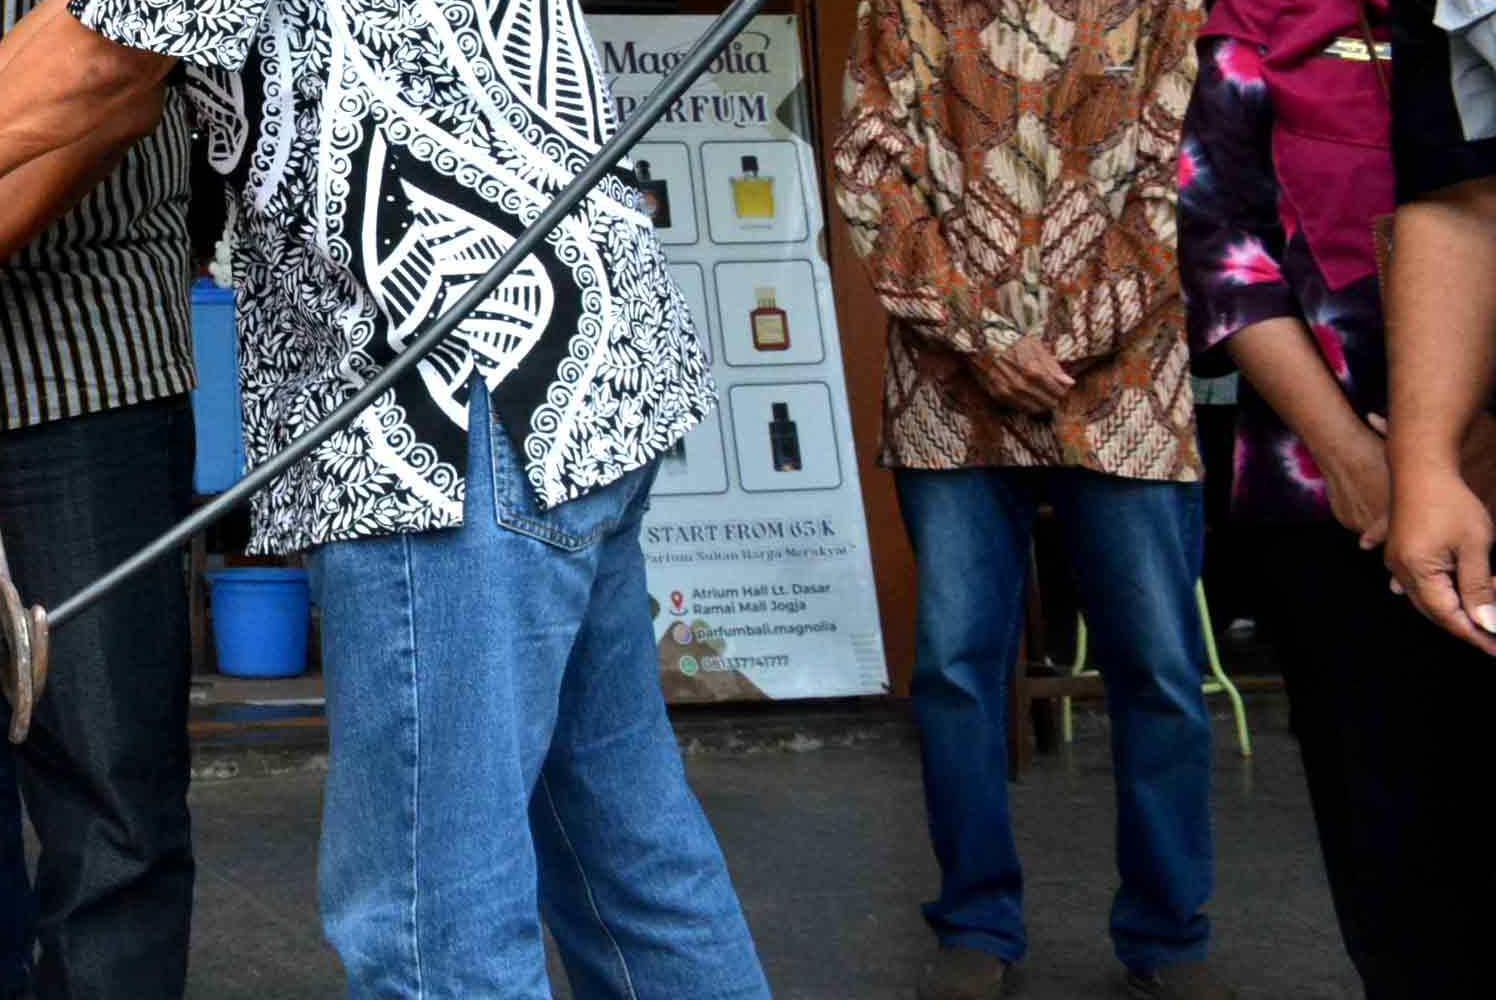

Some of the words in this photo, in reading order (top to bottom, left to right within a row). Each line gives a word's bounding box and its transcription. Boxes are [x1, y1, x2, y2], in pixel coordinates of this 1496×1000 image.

[602, 40, 771, 77] Magolia
[615, 94, 769, 125] PRFUM
[647, 523, 719, 544] START
[723, 519, 785, 542] FROM
[692, 585, 739, 600] Atrium
[742, 584, 769, 598] Hall
[792, 583, 832, 595] Dasar
[692, 602, 735, 616] Ramai
[738, 601, 767, 613] Mall
[770, 600, 808, 614] Jogja
